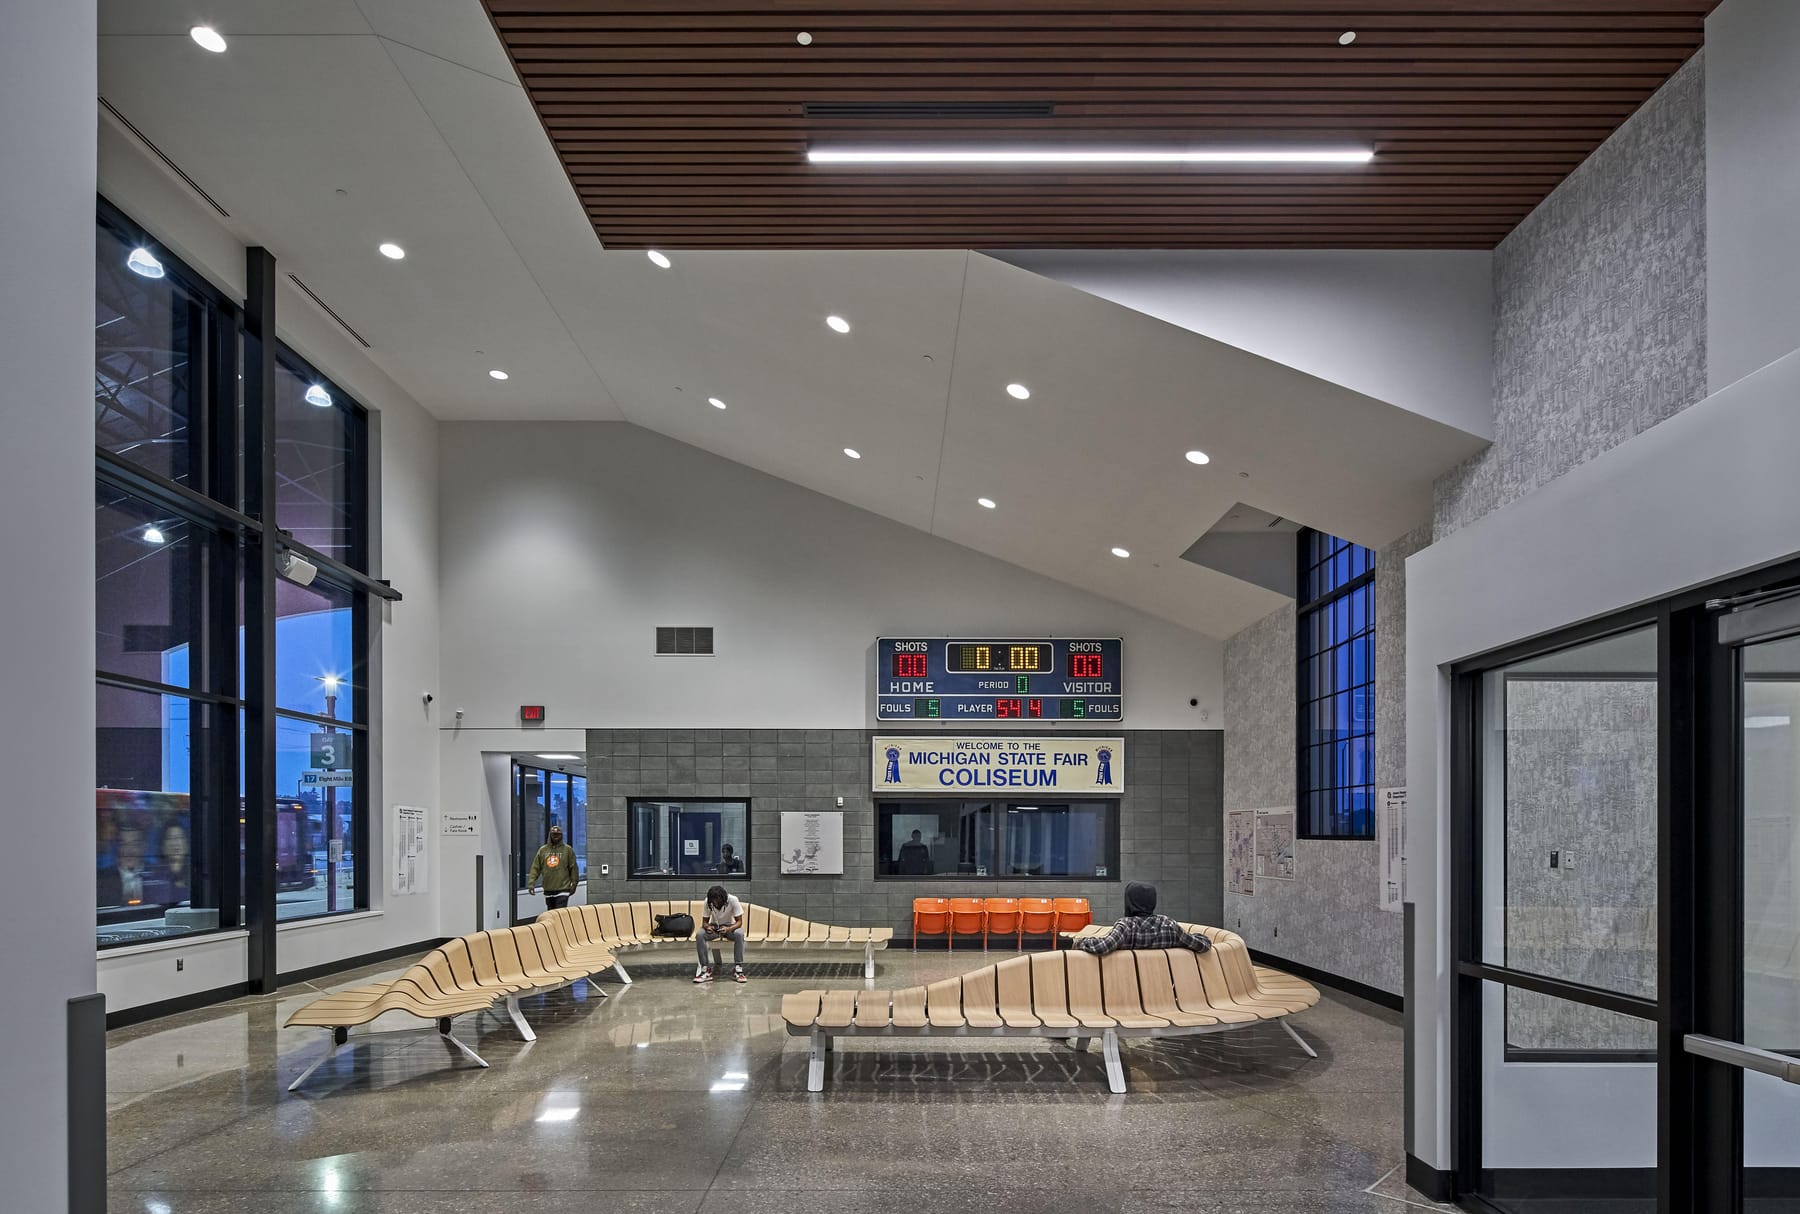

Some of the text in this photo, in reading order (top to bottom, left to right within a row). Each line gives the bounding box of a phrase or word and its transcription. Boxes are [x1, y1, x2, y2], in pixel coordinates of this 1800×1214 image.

[894, 641, 928, 652] SHOTS
[1069, 642, 1102, 652] SHOTS
[898, 654, 926, 677] 00
[890, 681, 934, 693] HOME
[978, 681, 1009, 689] PERIOD
[1063, 682, 1112, 693] VISITOR
[525, 707, 539, 719] EXIT
[880, 703, 911, 712] FOULS
[957, 704, 993, 713] PLAYER
[1088, 704, 1119, 713] FOULS
[956, 741, 1041, 751] WELCOME TO THE
[321, 745, 336, 765] 3
[909, 751, 1088, 766] MICHIGAN STATE FAIR
[938, 767, 1057, 787] COLISEUM
